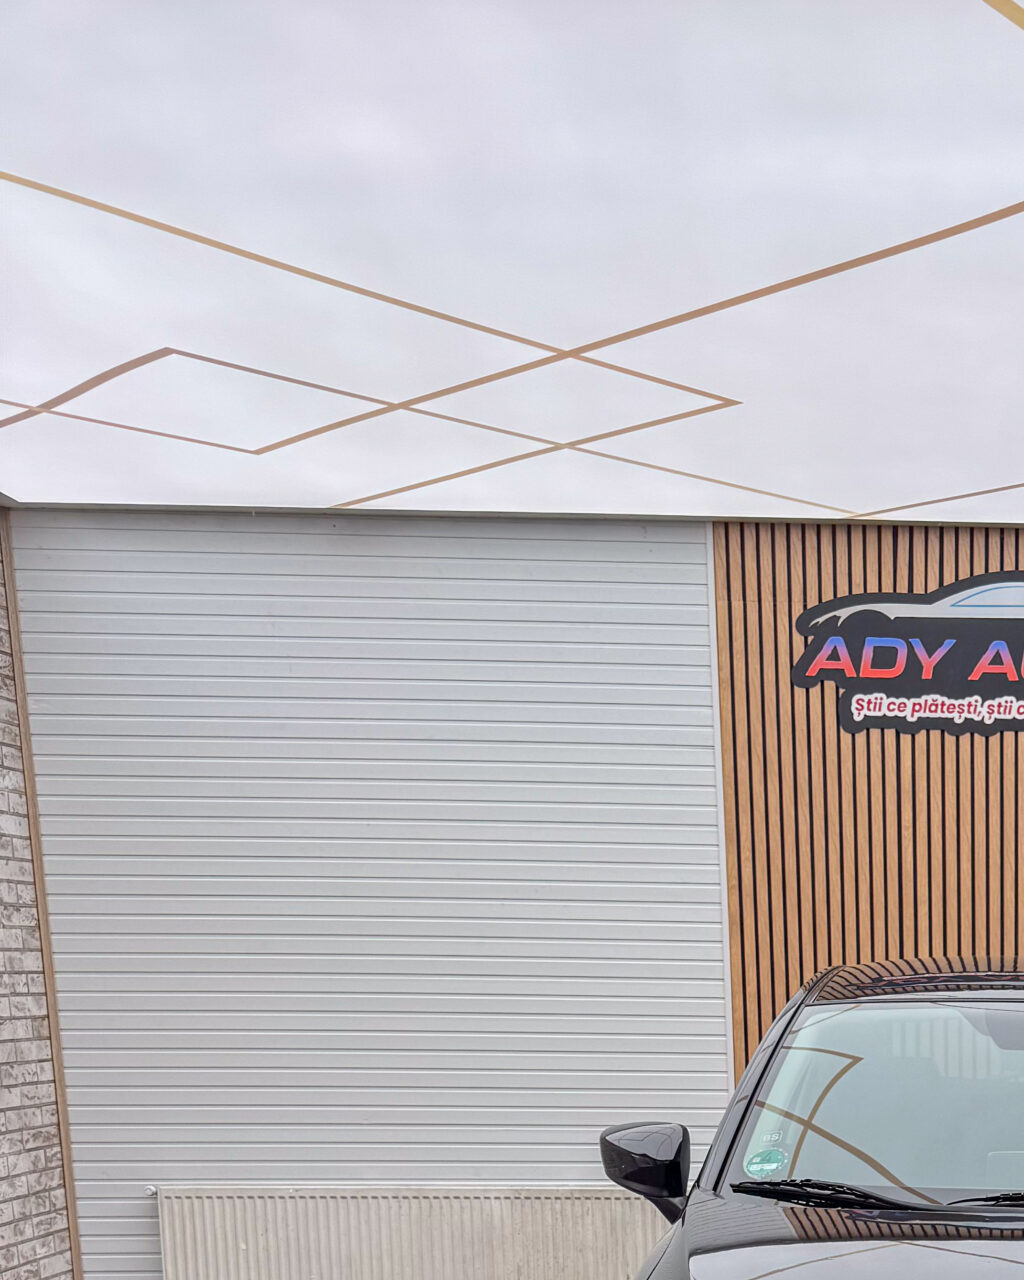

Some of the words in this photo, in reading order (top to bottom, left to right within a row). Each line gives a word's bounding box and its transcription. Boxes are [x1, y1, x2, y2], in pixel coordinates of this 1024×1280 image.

[805, 635, 957, 680] ADY
[854, 697, 884, 718] Știi
[886, 701, 907, 713] ce
[910, 698, 982, 720] plătești,
[986, 699, 1014, 720] știi
